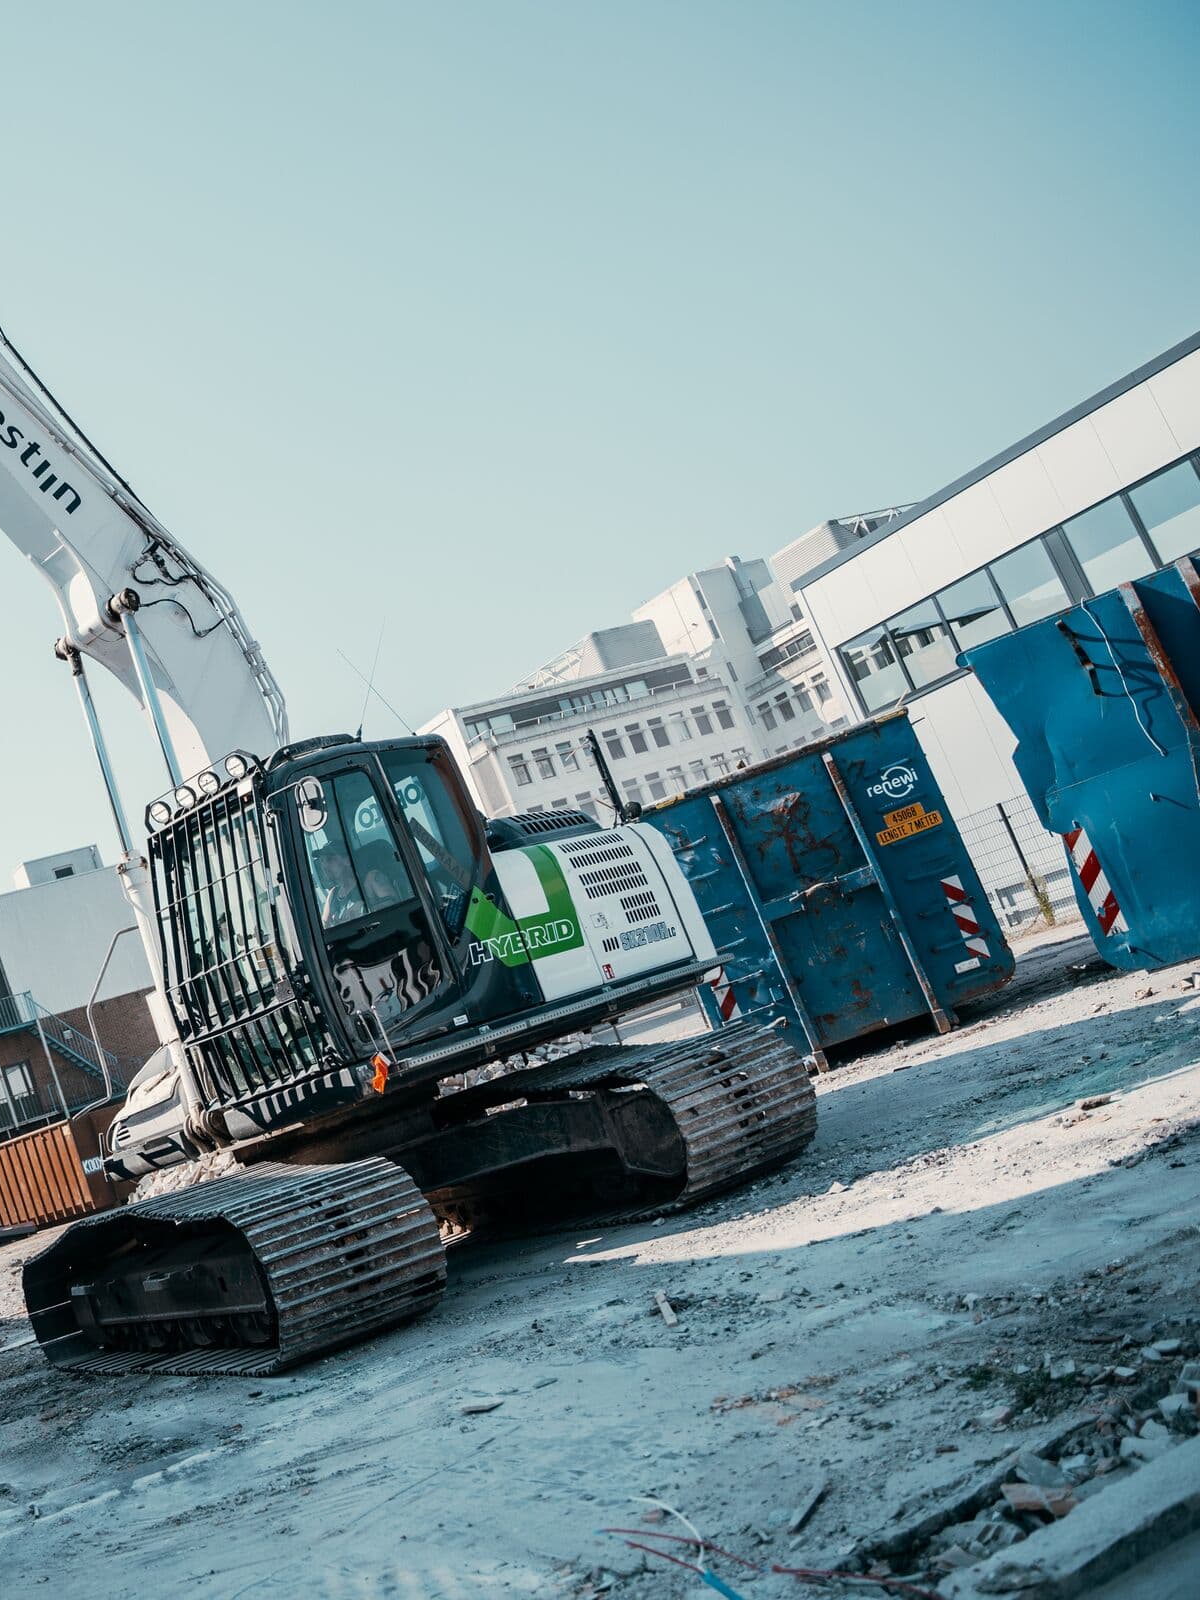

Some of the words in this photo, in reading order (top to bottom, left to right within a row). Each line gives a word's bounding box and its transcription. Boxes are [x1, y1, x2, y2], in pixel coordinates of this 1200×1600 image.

[866, 767, 919, 798] renewi
[879, 825, 908, 844] LENGTE
[908, 822, 914, 832] 7
[914, 813, 939, 831] METER
[469, 918, 575, 966] HYBRID
